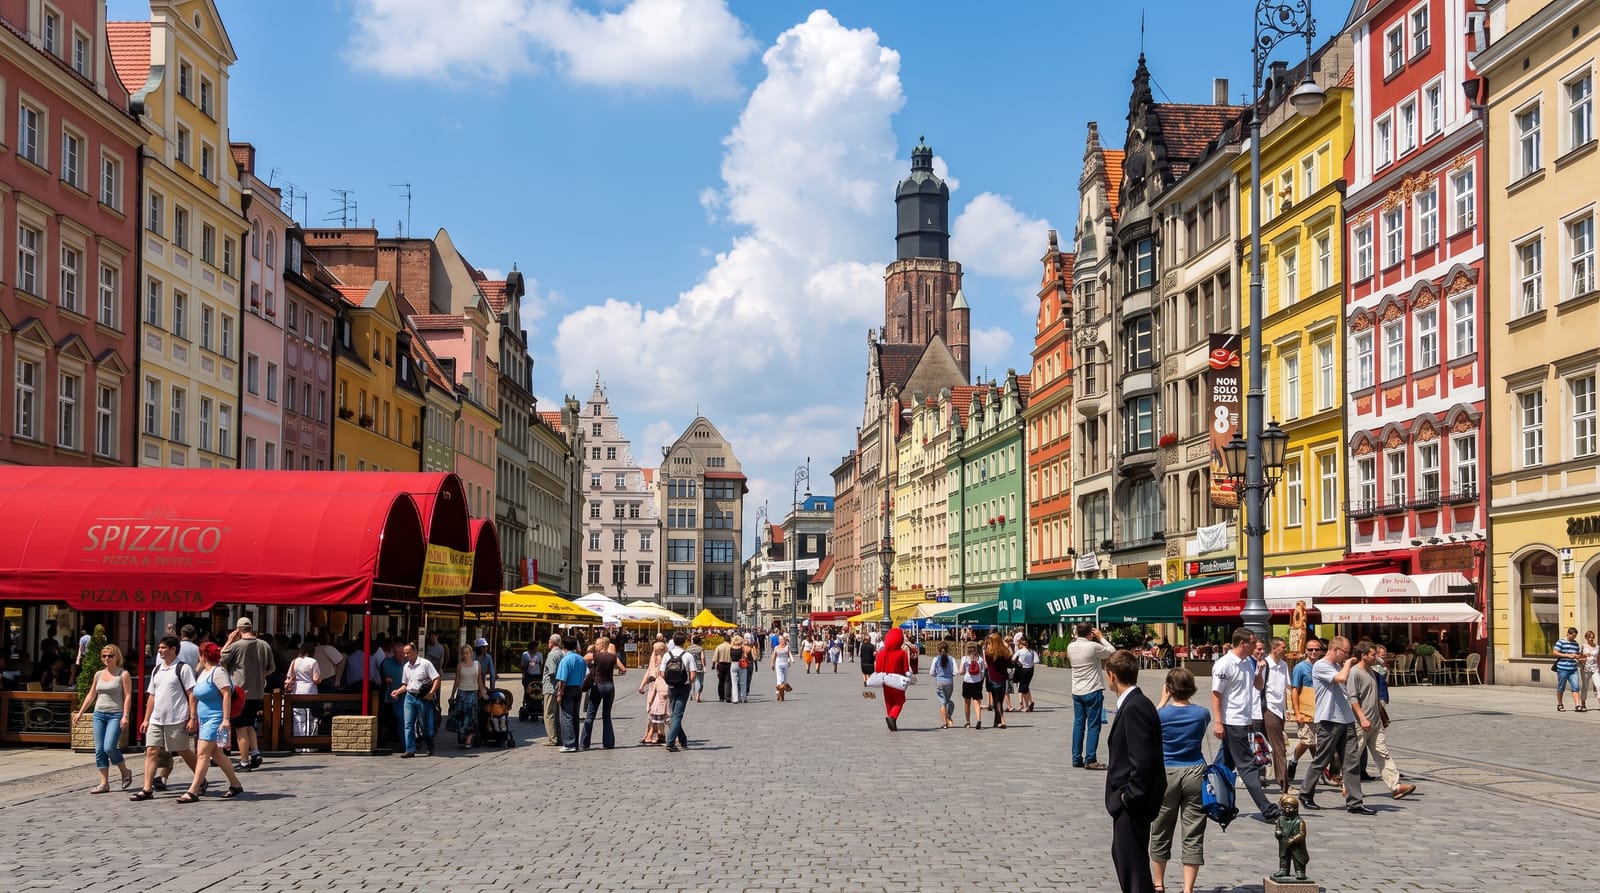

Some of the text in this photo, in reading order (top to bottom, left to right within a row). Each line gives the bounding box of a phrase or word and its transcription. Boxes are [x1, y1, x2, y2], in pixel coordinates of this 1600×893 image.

[1216, 378, 1237, 386] NON
[1213, 385, 1238, 394] SOLO
[1213, 395, 1238, 403] PIZZA
[1214, 405, 1230, 434] 8
[83, 524, 222, 553] SPIZZICO
[102, 555, 193, 567] PIZZA & PASTA
[80, 589, 204, 604] PIZZA & PASTA
